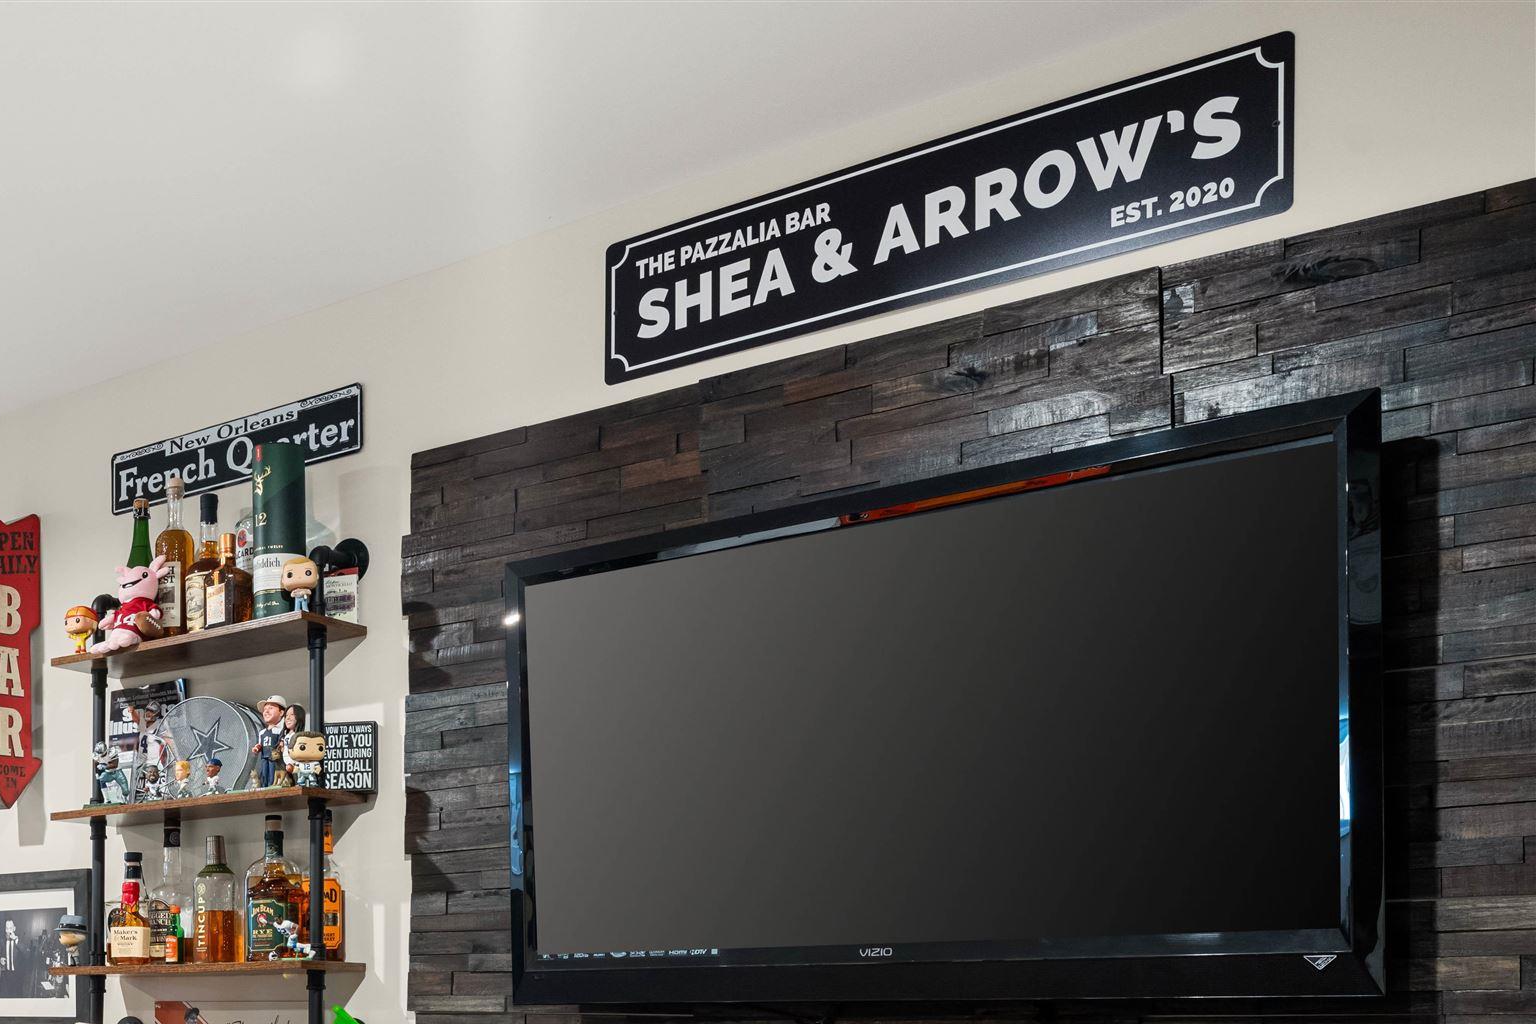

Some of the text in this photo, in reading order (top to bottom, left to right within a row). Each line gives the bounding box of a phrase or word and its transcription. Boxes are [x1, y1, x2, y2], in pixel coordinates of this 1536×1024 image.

[1110, 177, 1235, 228] EST. 2020
[636, 95, 1242, 339] SHEA & ARROW'S
[636, 203, 831, 279] THE PAZZALIA BAR
[168, 410, 295, 454] New Orleans
[226, 417, 355, 474] Qrter
[255, 512, 268, 527] 12
[325, 725, 372, 735] VOW TO ALWAYS
[351, 734, 372, 747] YOU
[344, 748, 372, 758] DURING
[6, 777, 17, 788] IN
[859, 947, 893, 957] VIZIO
